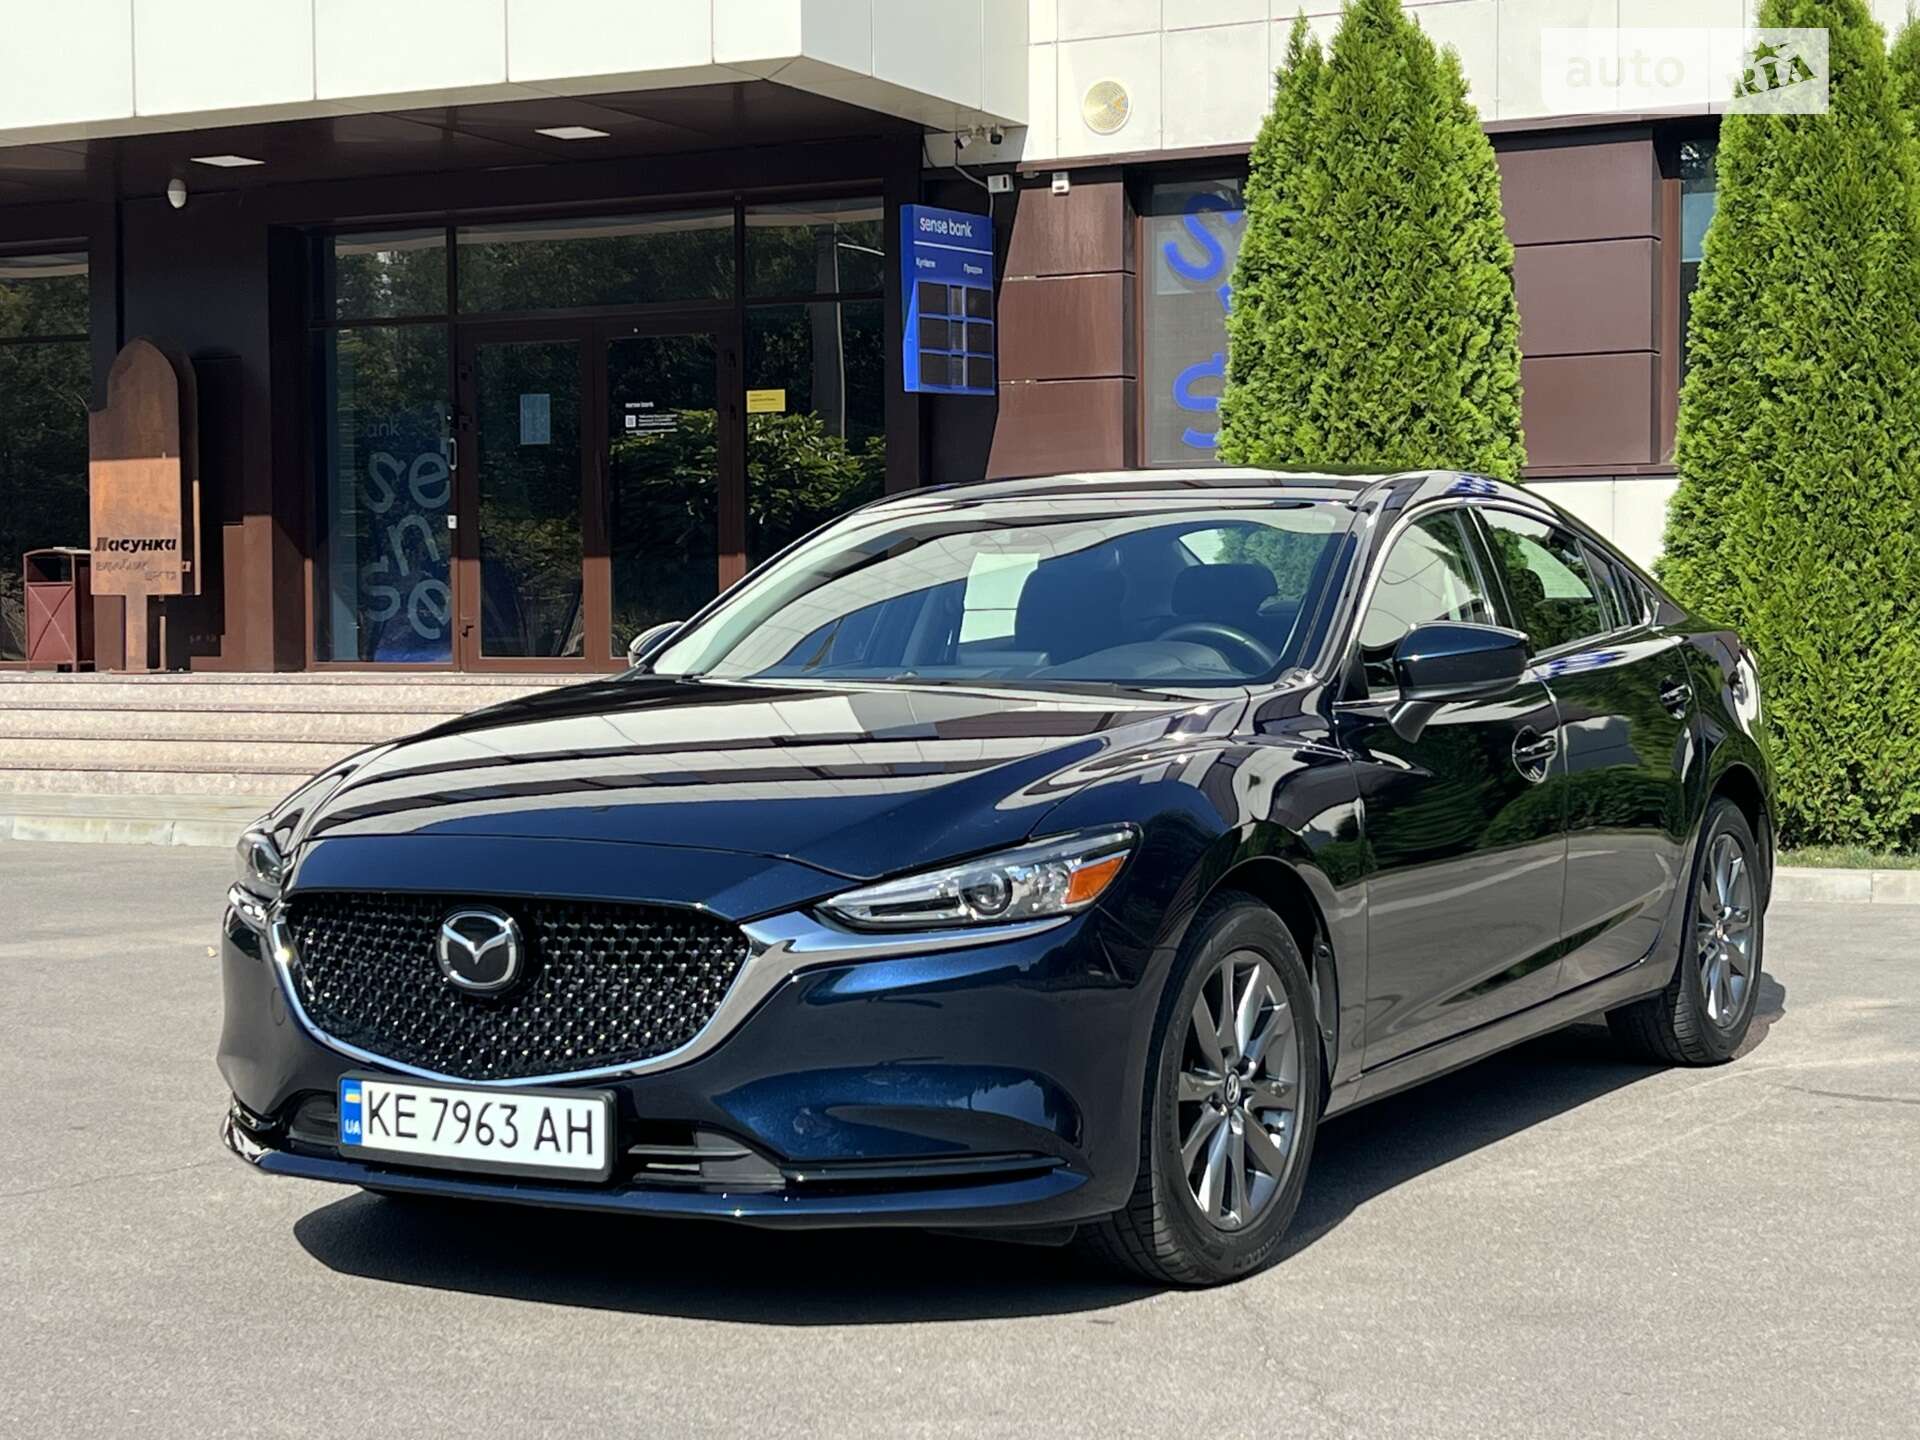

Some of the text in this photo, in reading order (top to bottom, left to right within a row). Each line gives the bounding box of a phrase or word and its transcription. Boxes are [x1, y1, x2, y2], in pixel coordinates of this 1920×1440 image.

[920, 217, 972, 237] sense bank
[345, 1119, 361, 1135] UA
[368, 1090, 593, 1155] KE 7963 AH
